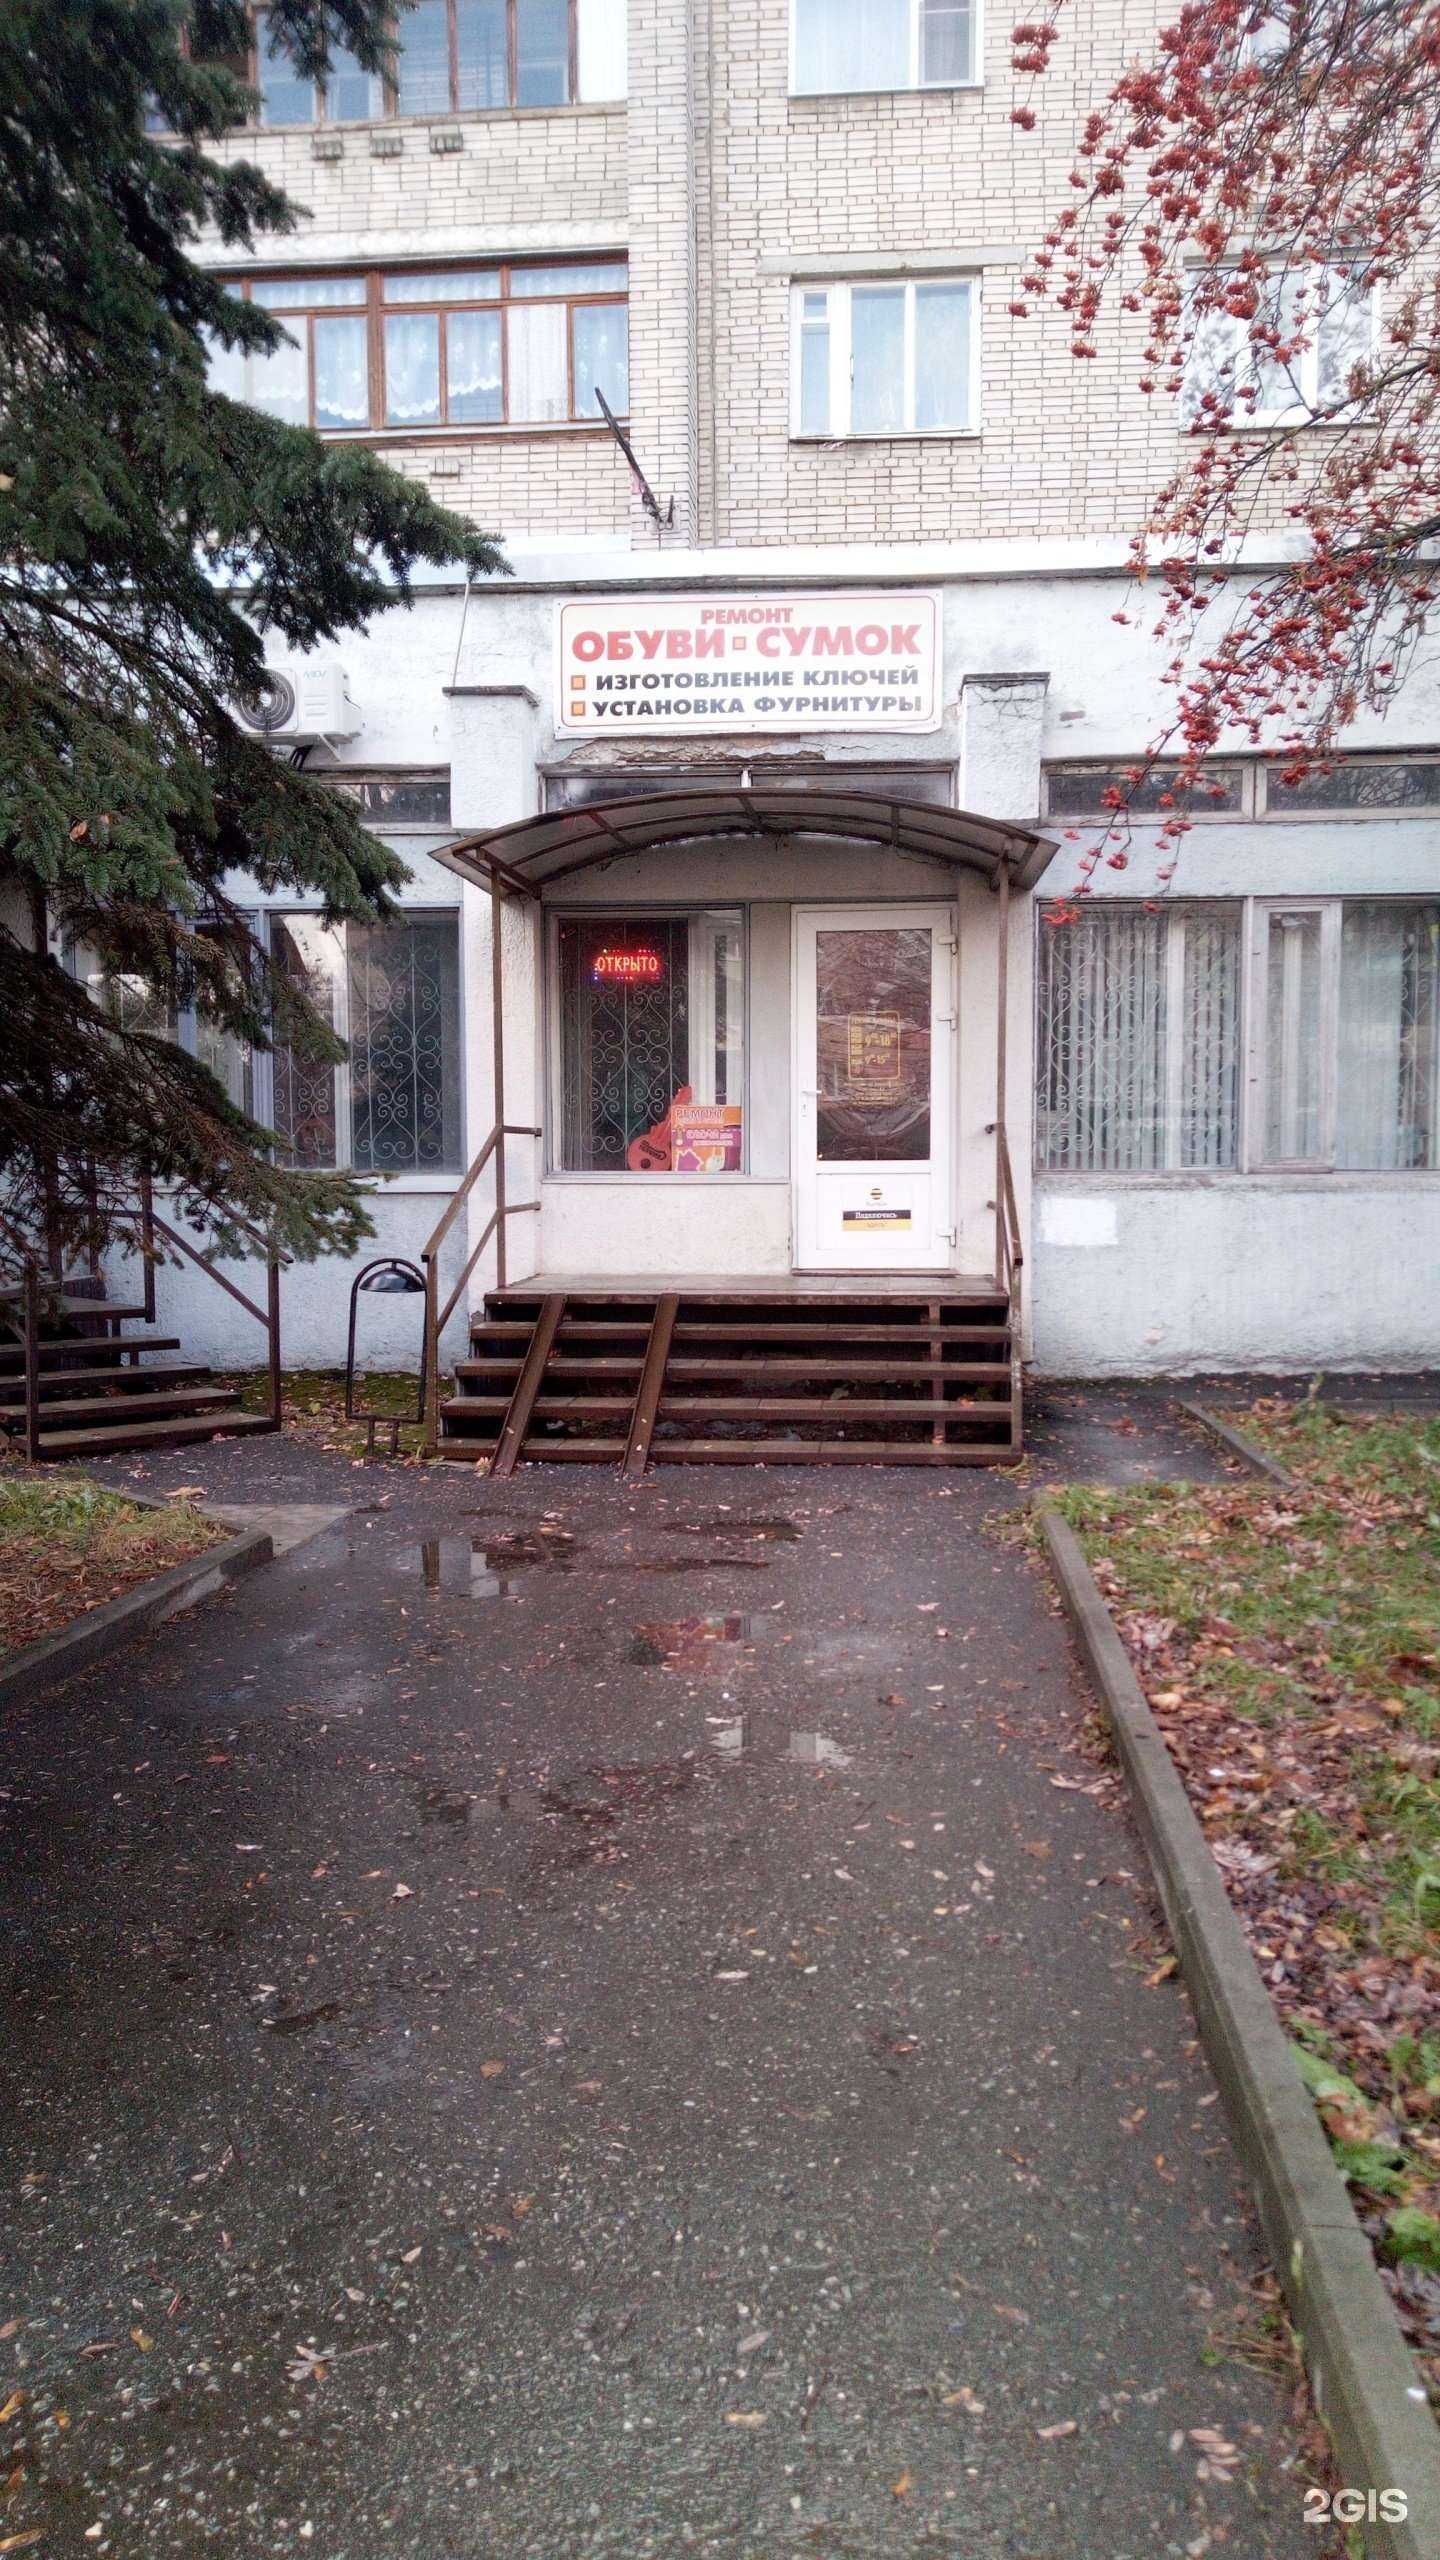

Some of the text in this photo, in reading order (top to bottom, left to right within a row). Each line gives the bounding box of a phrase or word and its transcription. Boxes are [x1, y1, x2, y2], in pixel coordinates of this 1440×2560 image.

[700, 607, 794, 625] РЕМОНТ
[571, 624, 922, 662] ОБУВИ СУМОК
[596, 665, 919, 691] ИЗГОТОВЛЕНИЕ КЛЮЧЕЙ
[592, 695, 922, 717] УСТАНОВКА ФУРНИТУРЫ
[597, 956, 658, 972] ОТКРЫТО
